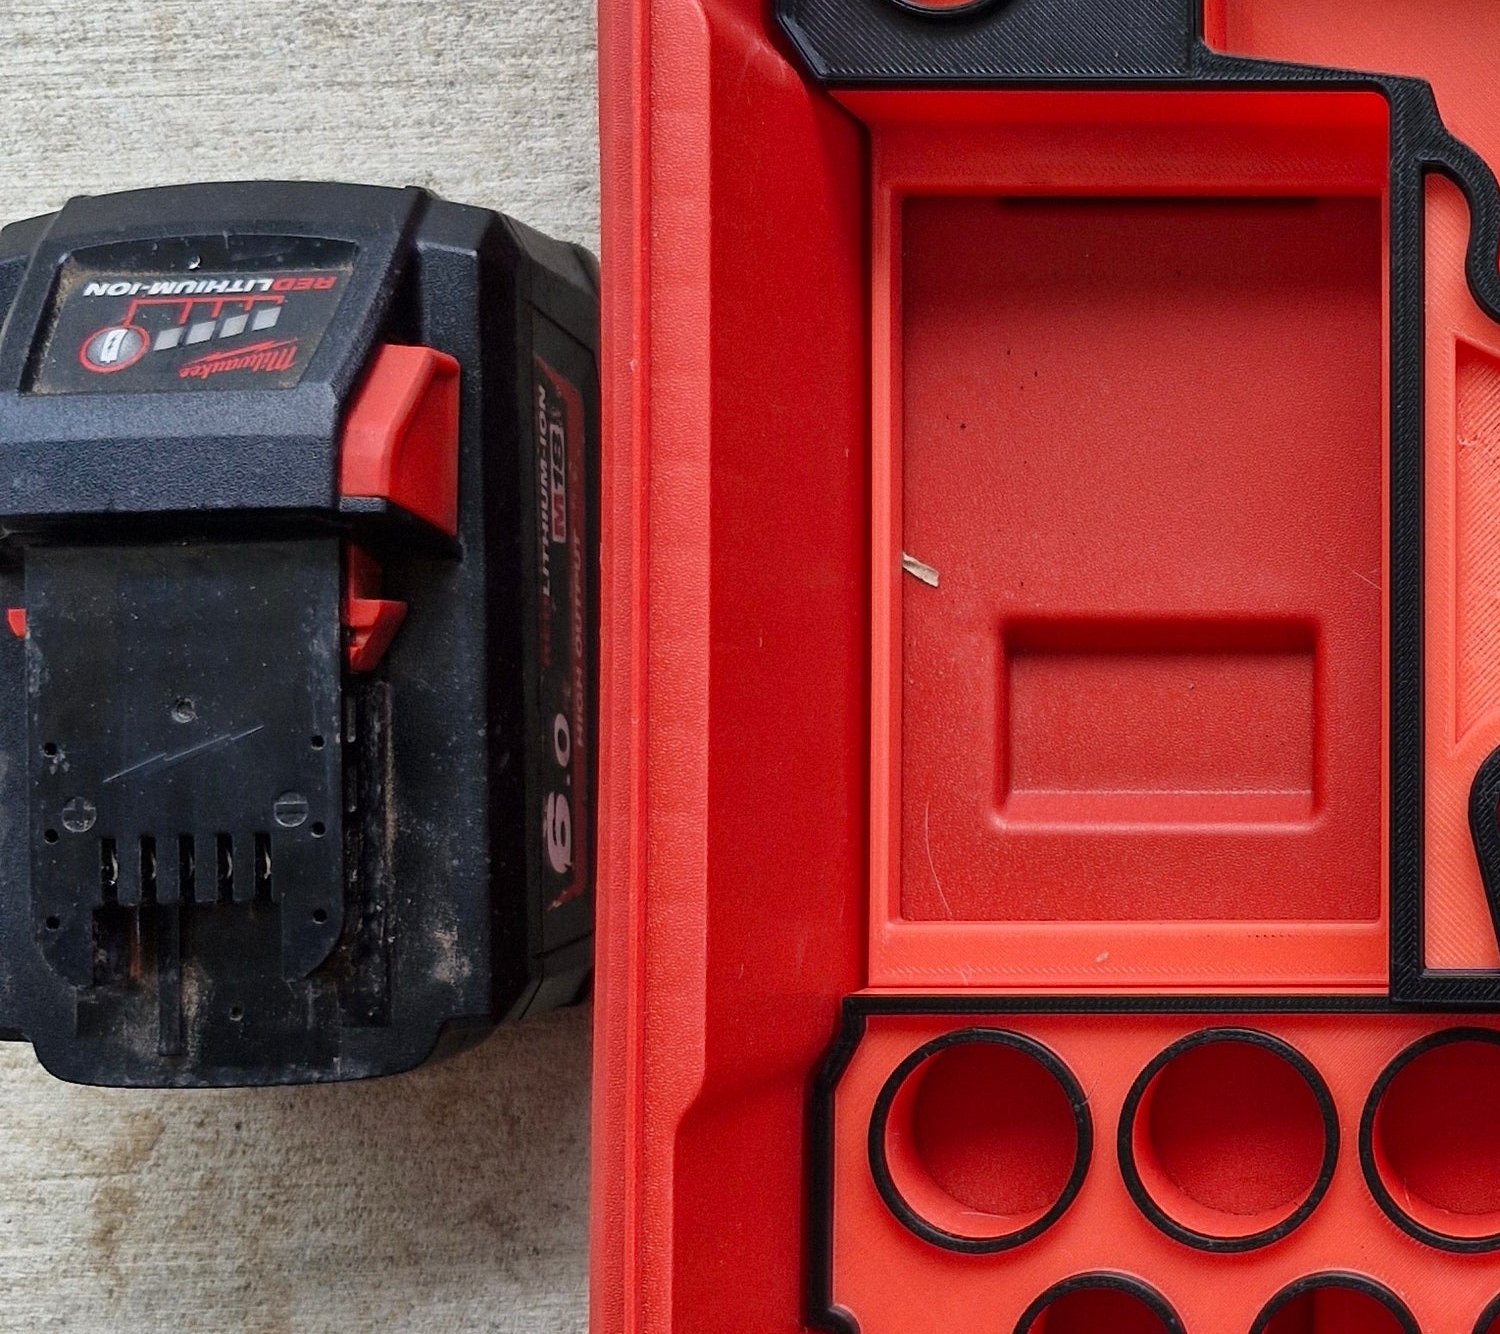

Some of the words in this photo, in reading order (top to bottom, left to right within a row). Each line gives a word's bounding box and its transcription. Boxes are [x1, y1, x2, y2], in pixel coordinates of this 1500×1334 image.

[83, 276, 337, 297] REDLITHIUM-ION
[179, 347, 298, 379] Milwaukee
[552, 426, 565, 540] M18
[573, 528, 583, 658] OUTPUT
[547, 713, 571, 874] 6.0
